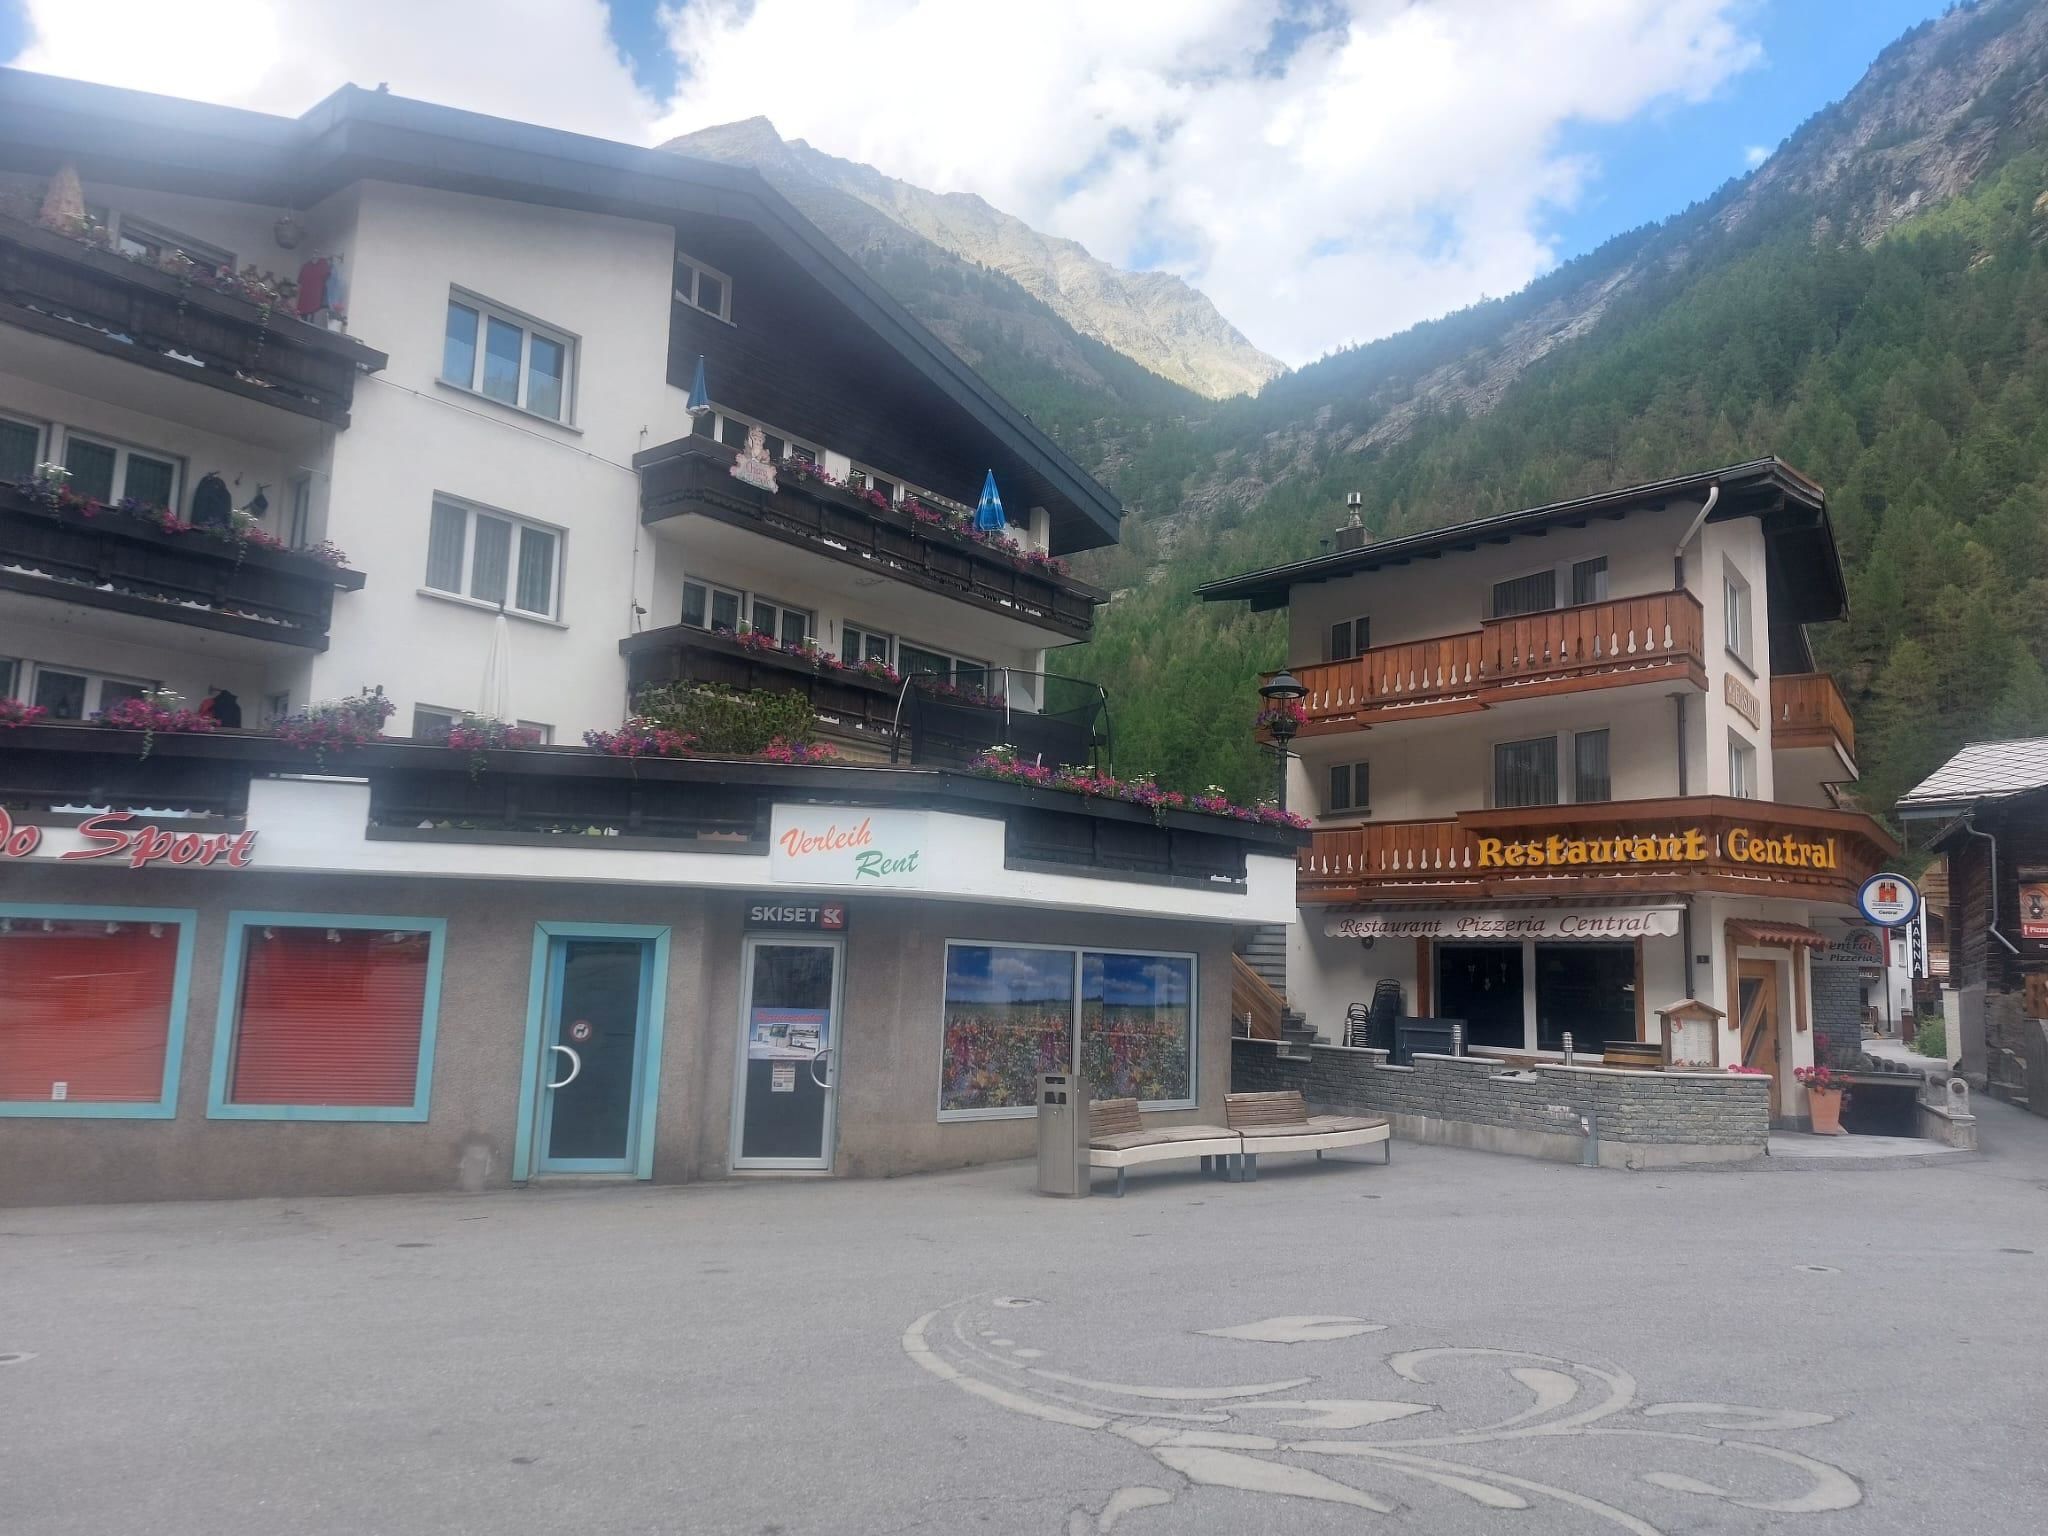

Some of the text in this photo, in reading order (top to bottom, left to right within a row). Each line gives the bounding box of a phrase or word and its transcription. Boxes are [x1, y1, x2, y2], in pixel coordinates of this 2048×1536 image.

[56, 811, 258, 869] Sport
[779, 816, 873, 858] Verleih
[1477, 826, 1838, 869] Restaurant Central
[855, 849, 920, 881] Rent
[750, 906, 820, 923] SKISET
[1339, 912, 1658, 934] Restaurant Pizzeria Central
[1827, 939, 1873, 951] entral
